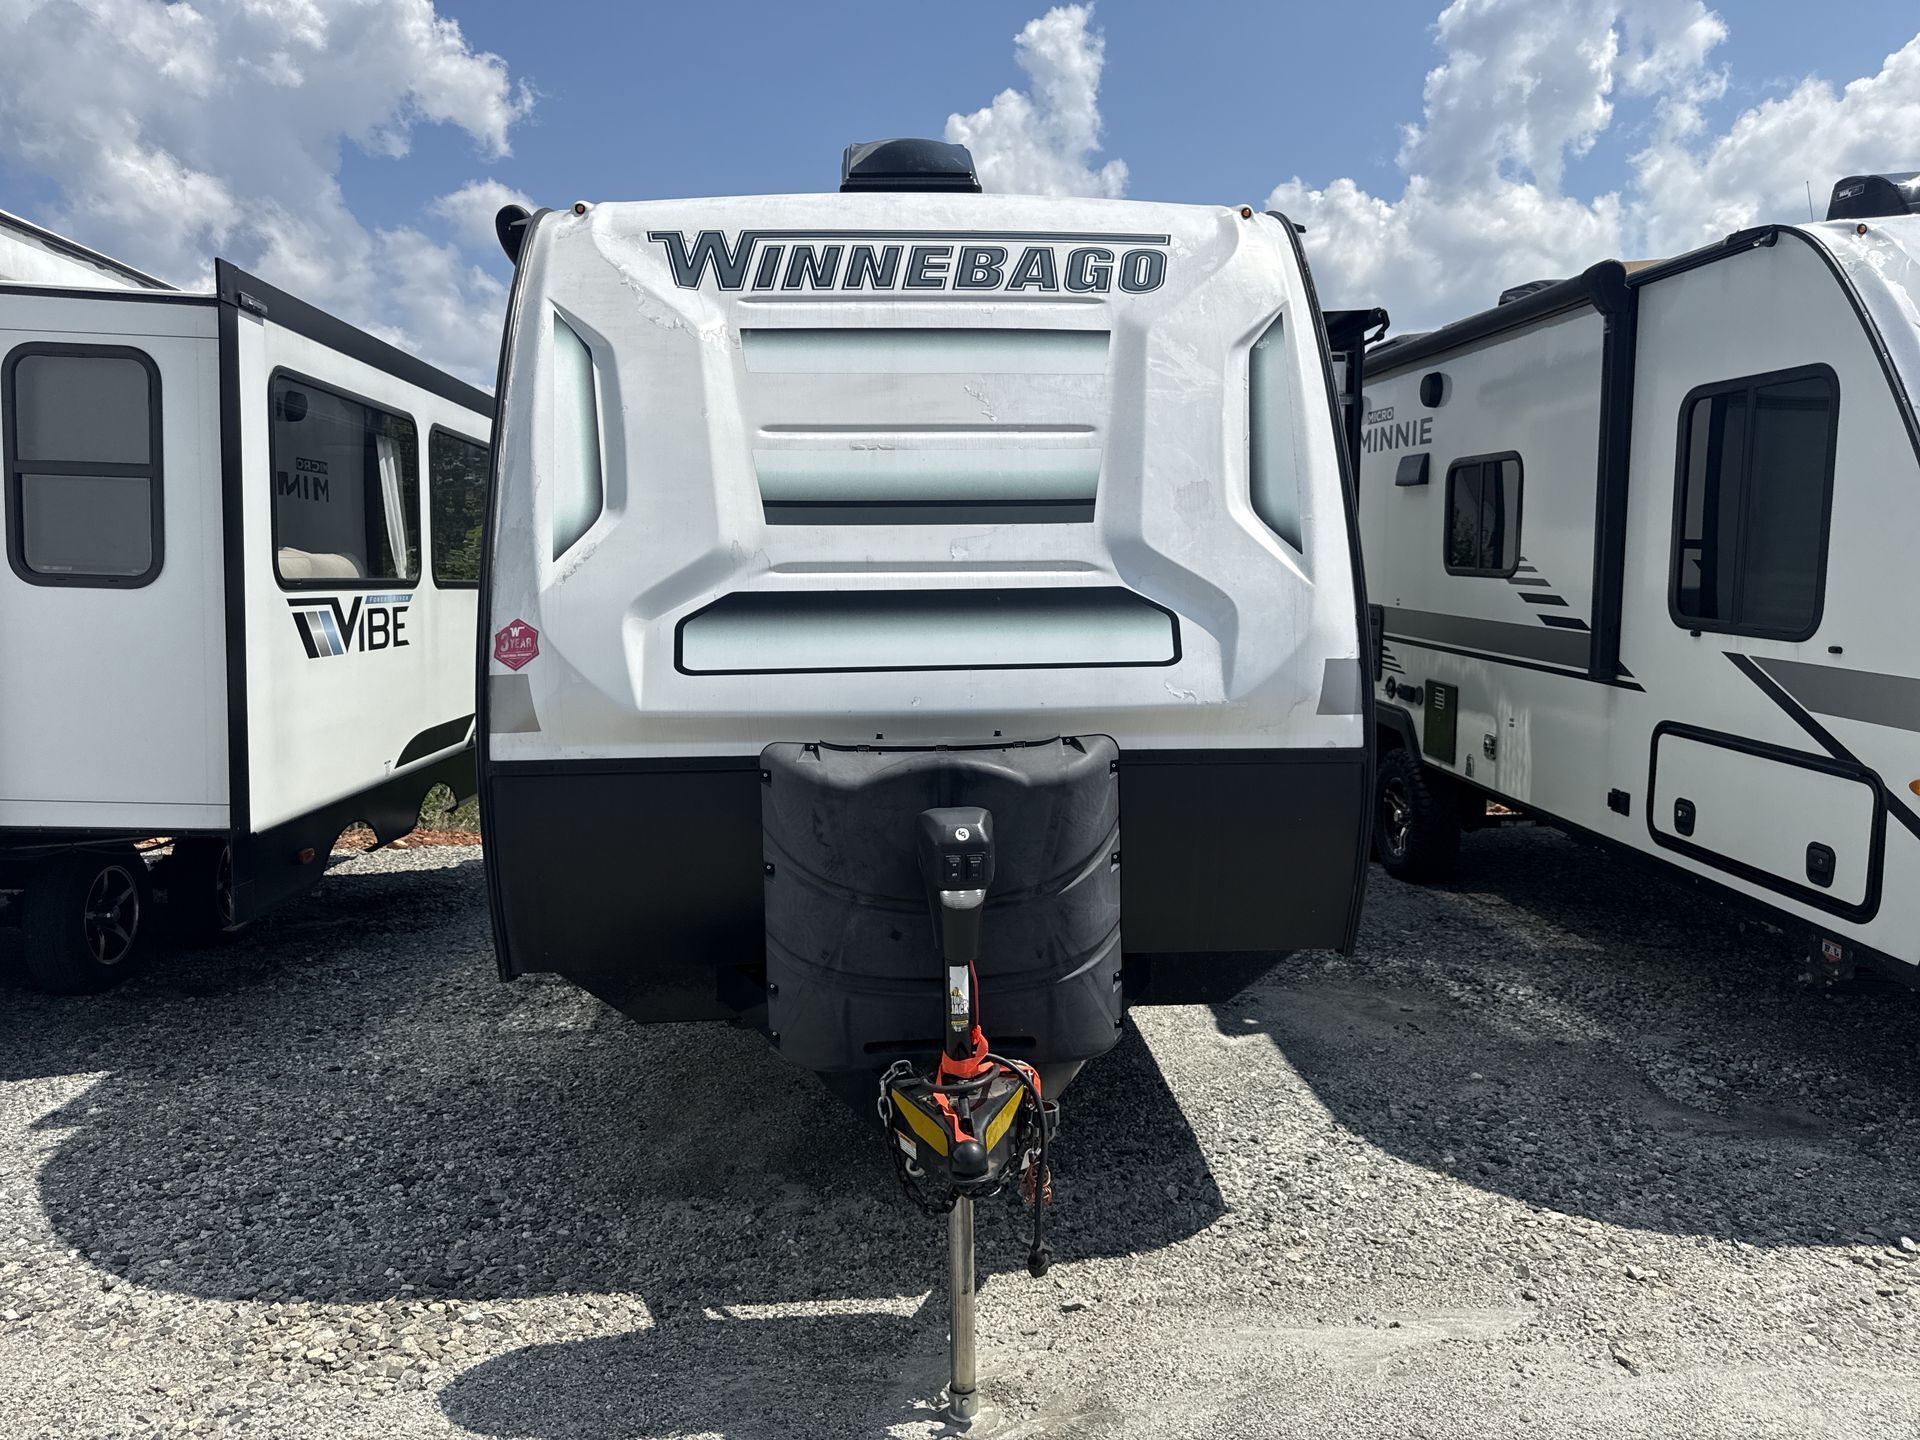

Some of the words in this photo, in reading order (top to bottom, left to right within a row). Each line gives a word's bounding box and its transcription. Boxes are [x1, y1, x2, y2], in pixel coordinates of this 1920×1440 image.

[647, 230, 1171, 294] WINNEBAGO
[1368, 407, 1394, 425] MICRO
[1361, 417, 1433, 453] MINNIE
[286, 596, 410, 655] VIBE
[500, 632, 510, 652] 3
[510, 637, 532, 649] YEAR
[951, 1004, 969, 1015] JACK
